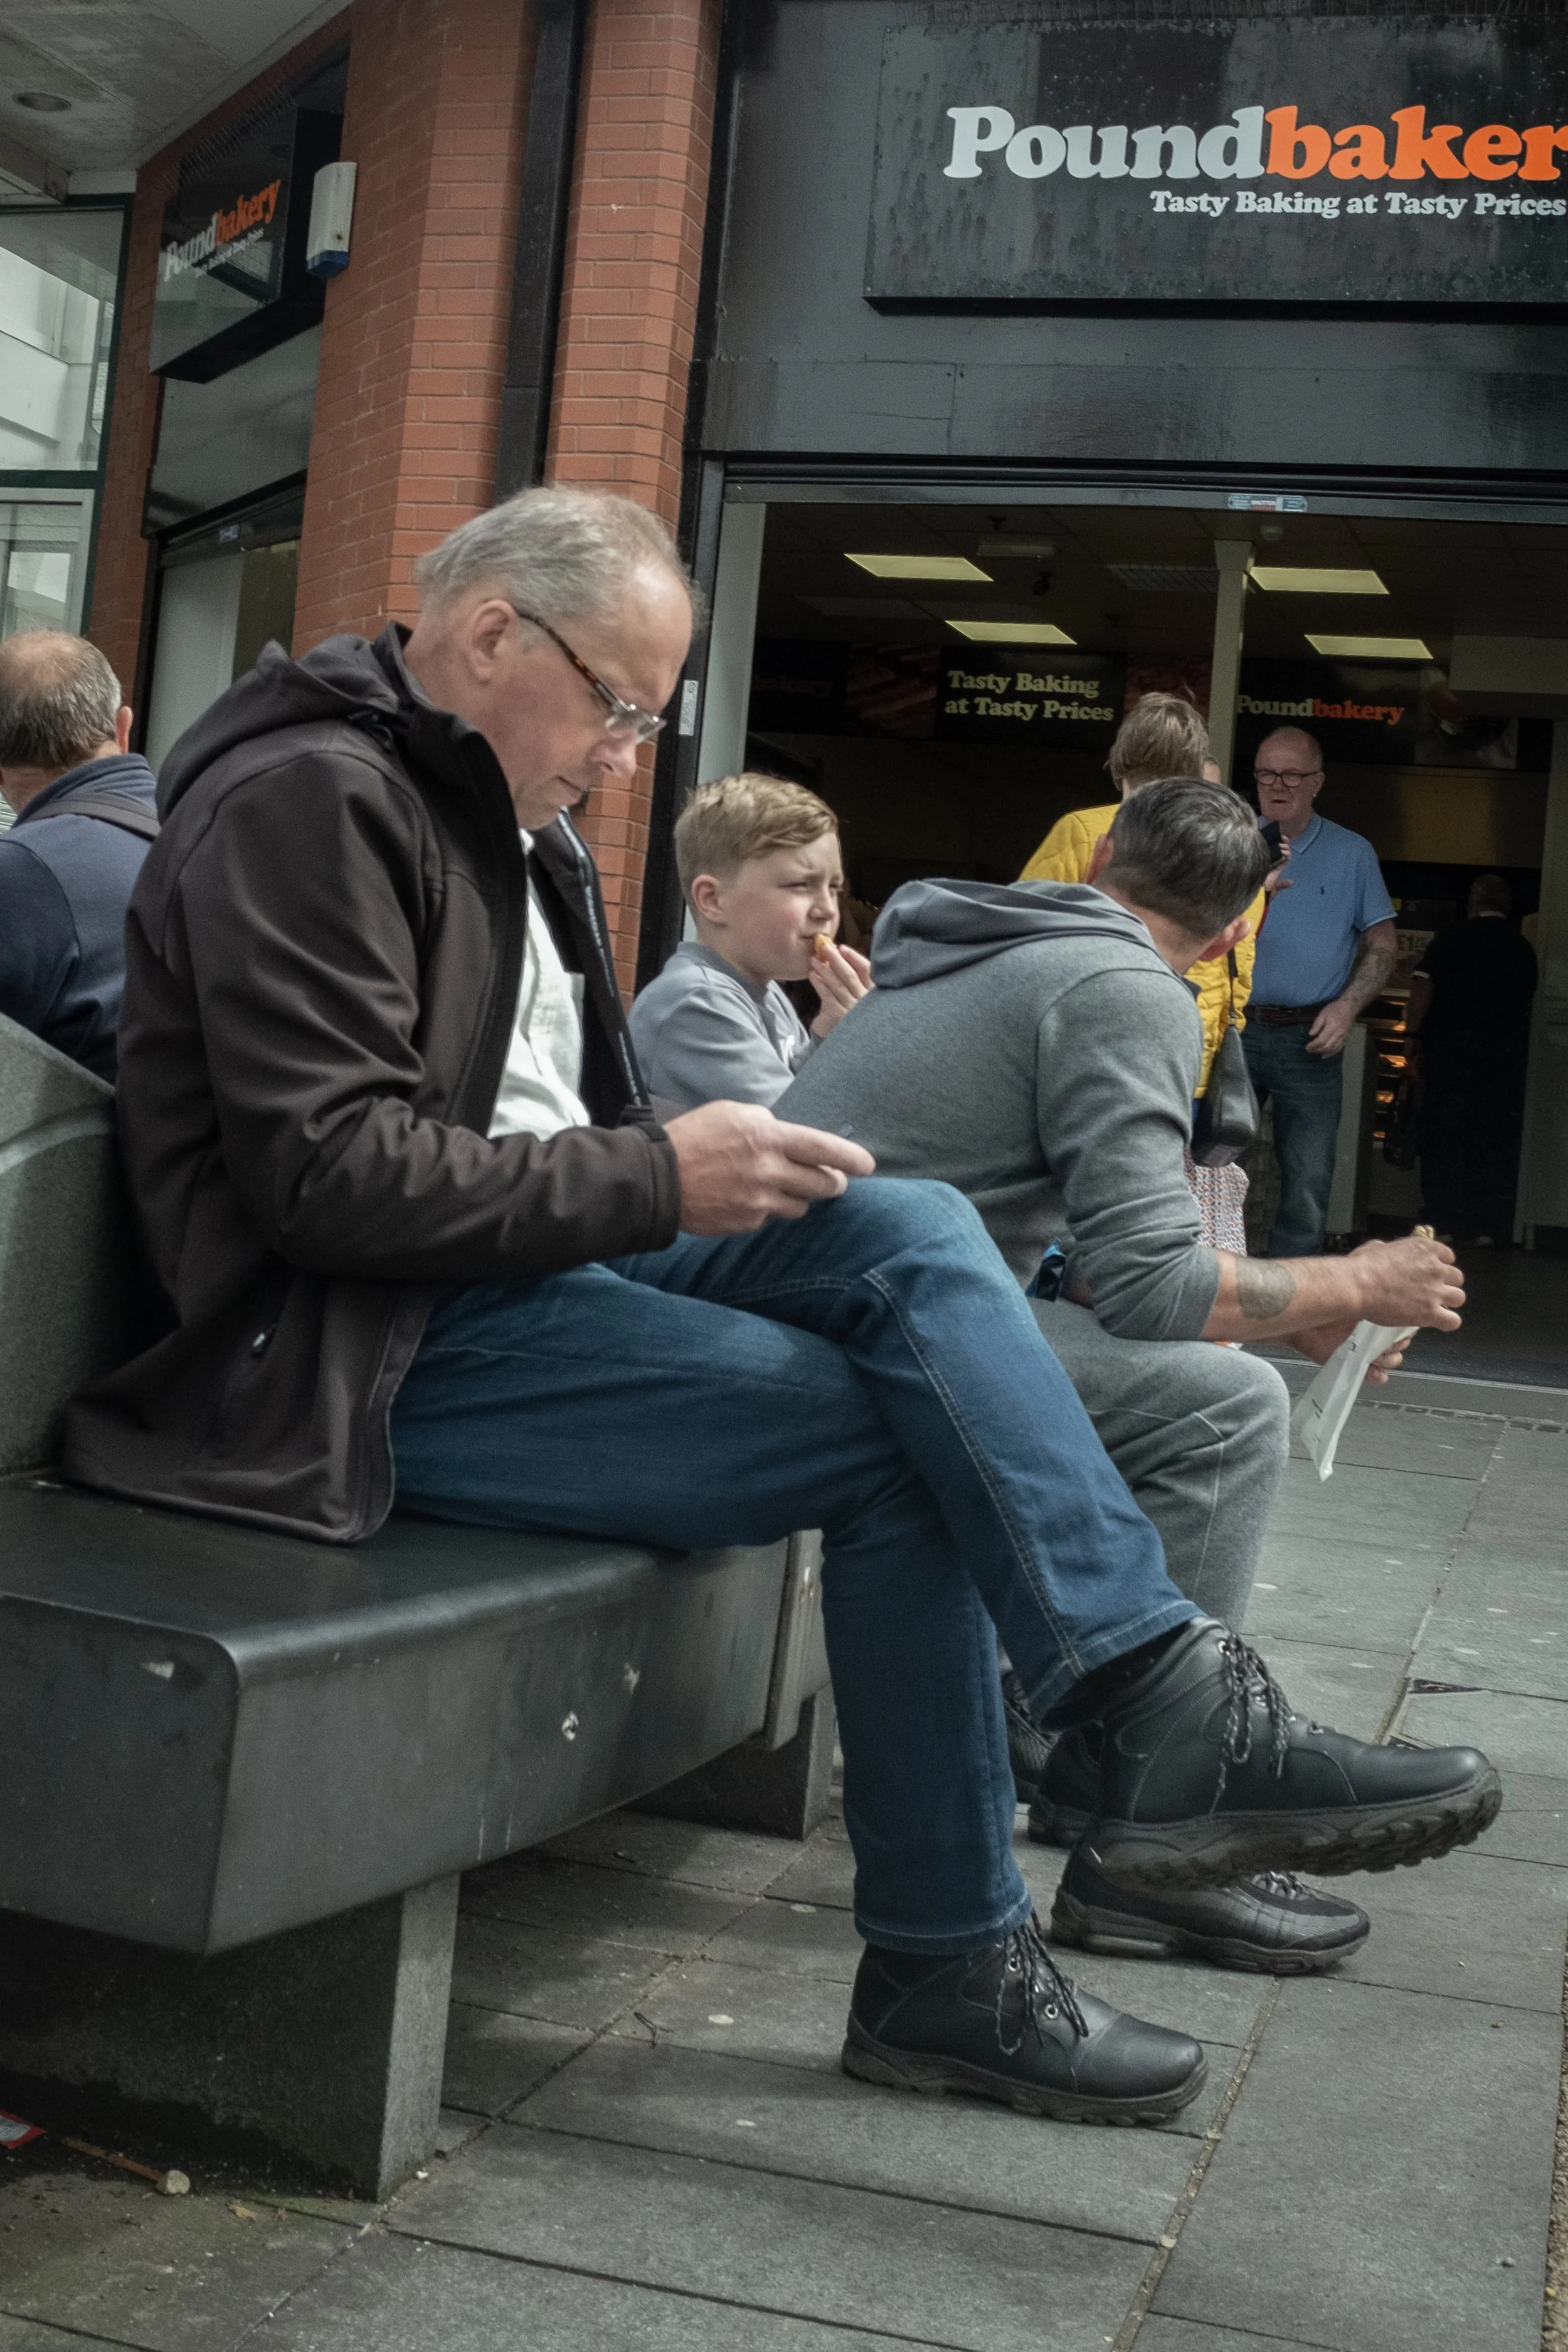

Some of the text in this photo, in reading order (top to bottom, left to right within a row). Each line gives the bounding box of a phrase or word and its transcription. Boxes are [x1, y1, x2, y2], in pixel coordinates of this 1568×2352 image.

[1149, 190, 1567, 220] Tasty Baking at Tasty Prices
[164, 178, 281, 282] Poundbakery
[947, 670, 1099, 699] Tasty Baking
[945, 696, 1115, 721] at Tasty Prices
[1236, 694, 1405, 726] Poundbakery
